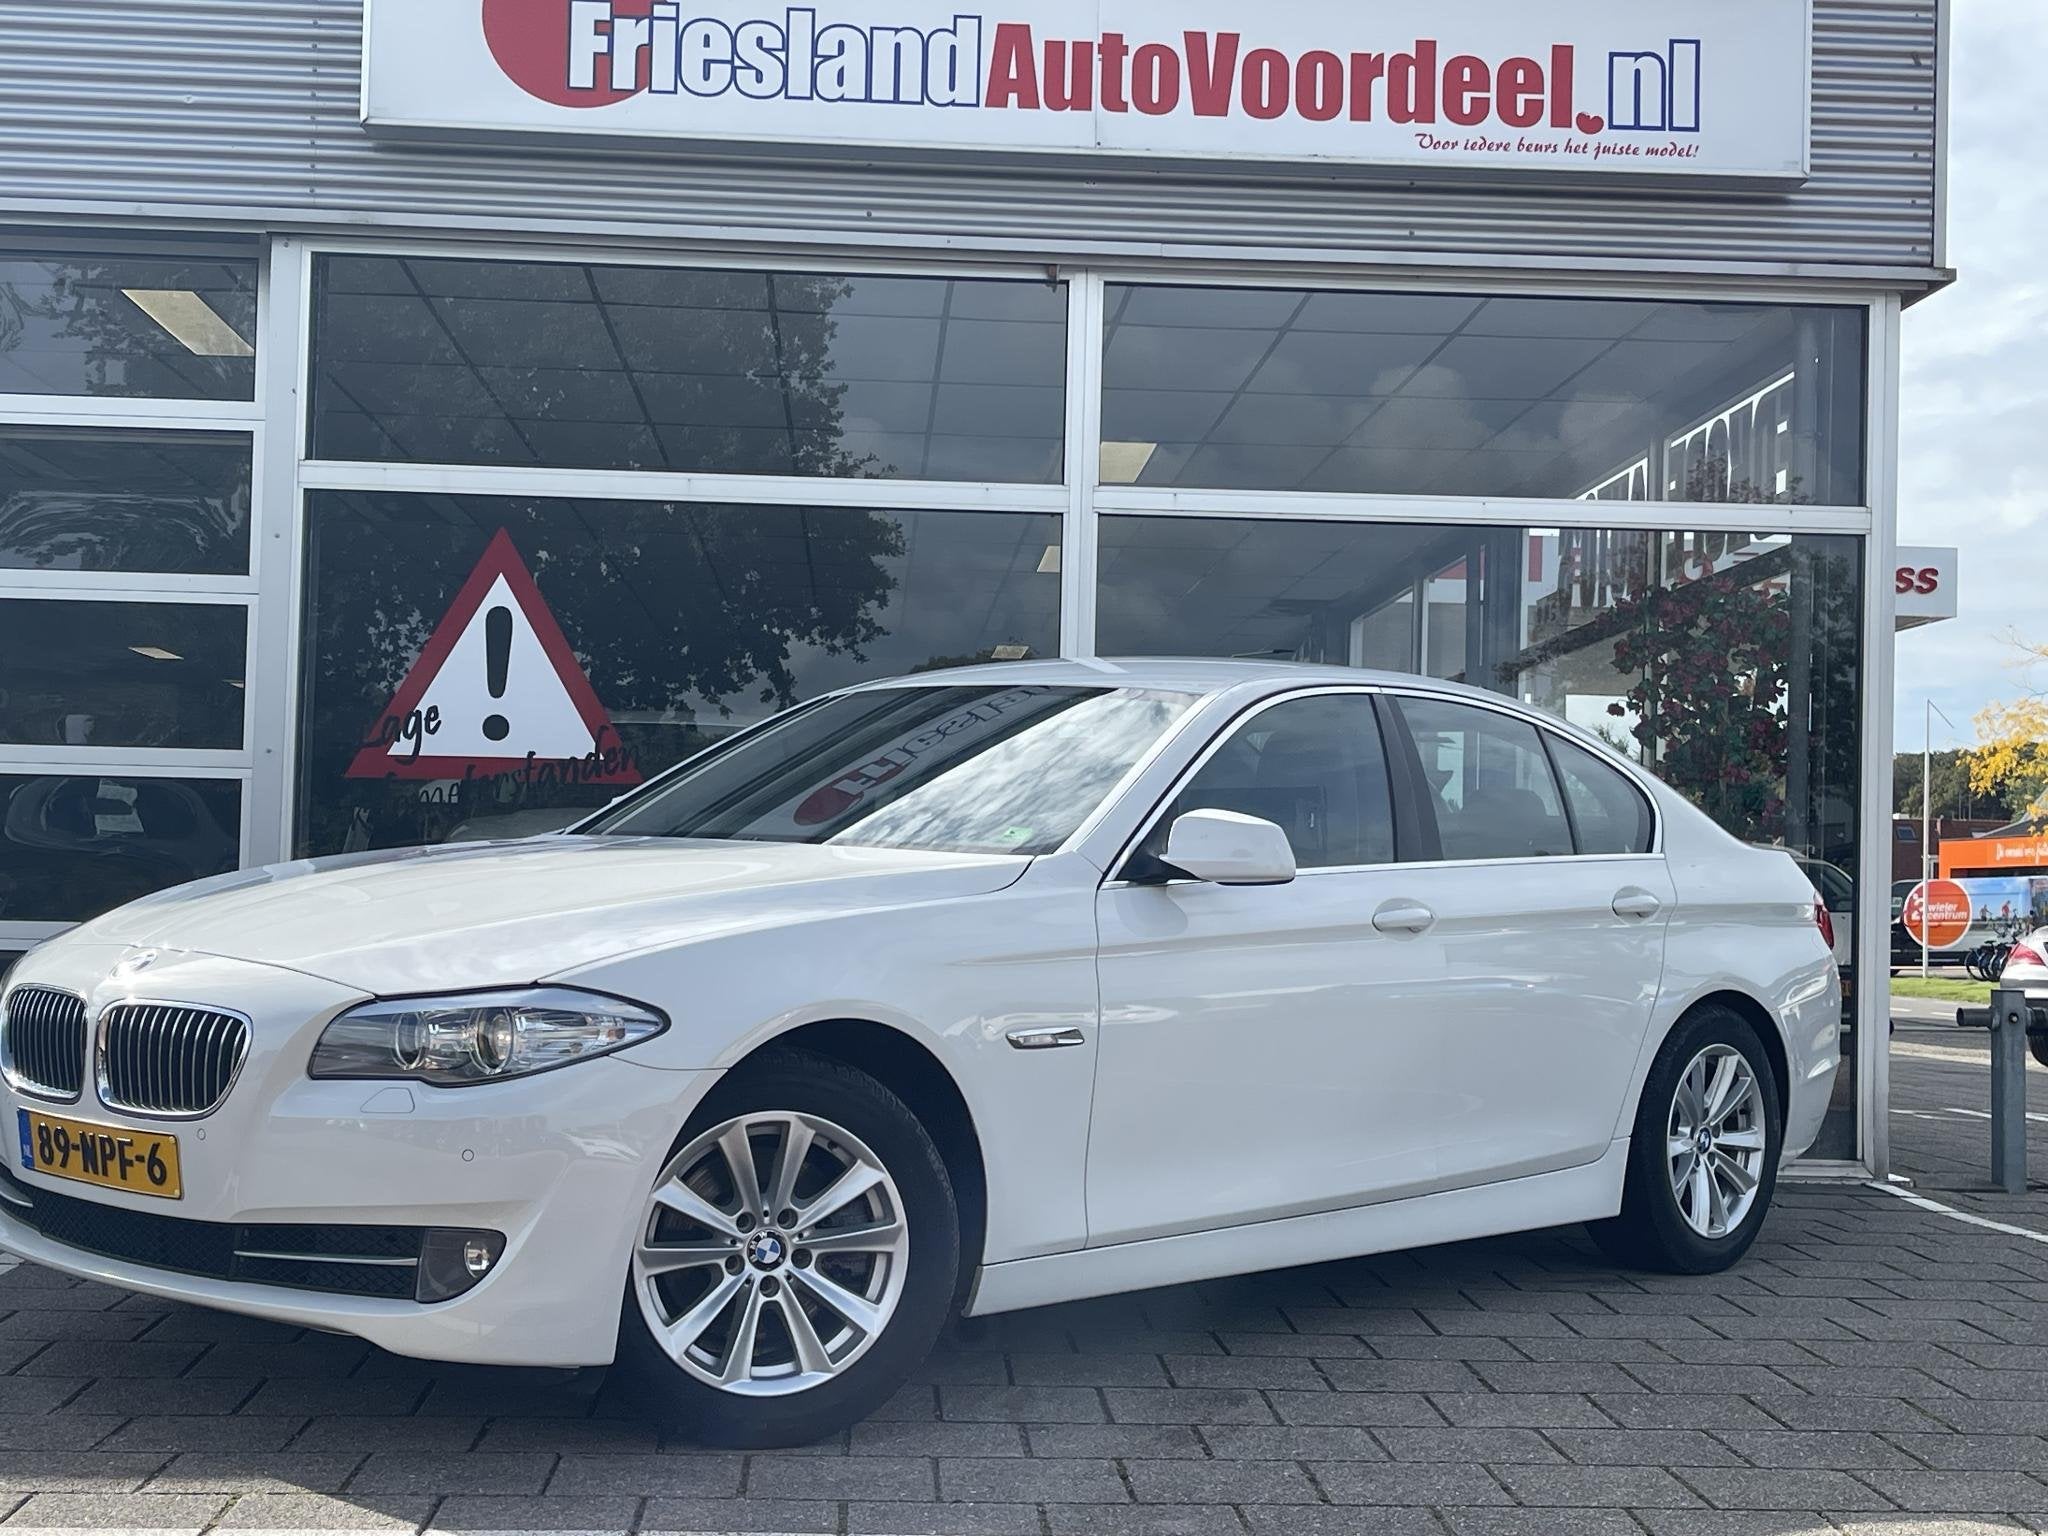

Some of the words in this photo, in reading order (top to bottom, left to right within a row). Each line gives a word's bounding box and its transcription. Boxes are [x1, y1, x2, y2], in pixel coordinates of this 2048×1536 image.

[566, 0, 1700, 135] FrieslandAutoVoordeel.nl
[1415, 133, 1458, 150] Voor
[1463, 136, 1511, 152] iedere
[1517, 136, 1558, 154] beurs
[1564, 138, 1588, 154] het
[1593, 142, 1640, 160] juiste
[1645, 141, 1699, 158] model!
[37, 1121, 168, 1186] 89-NPF-6
